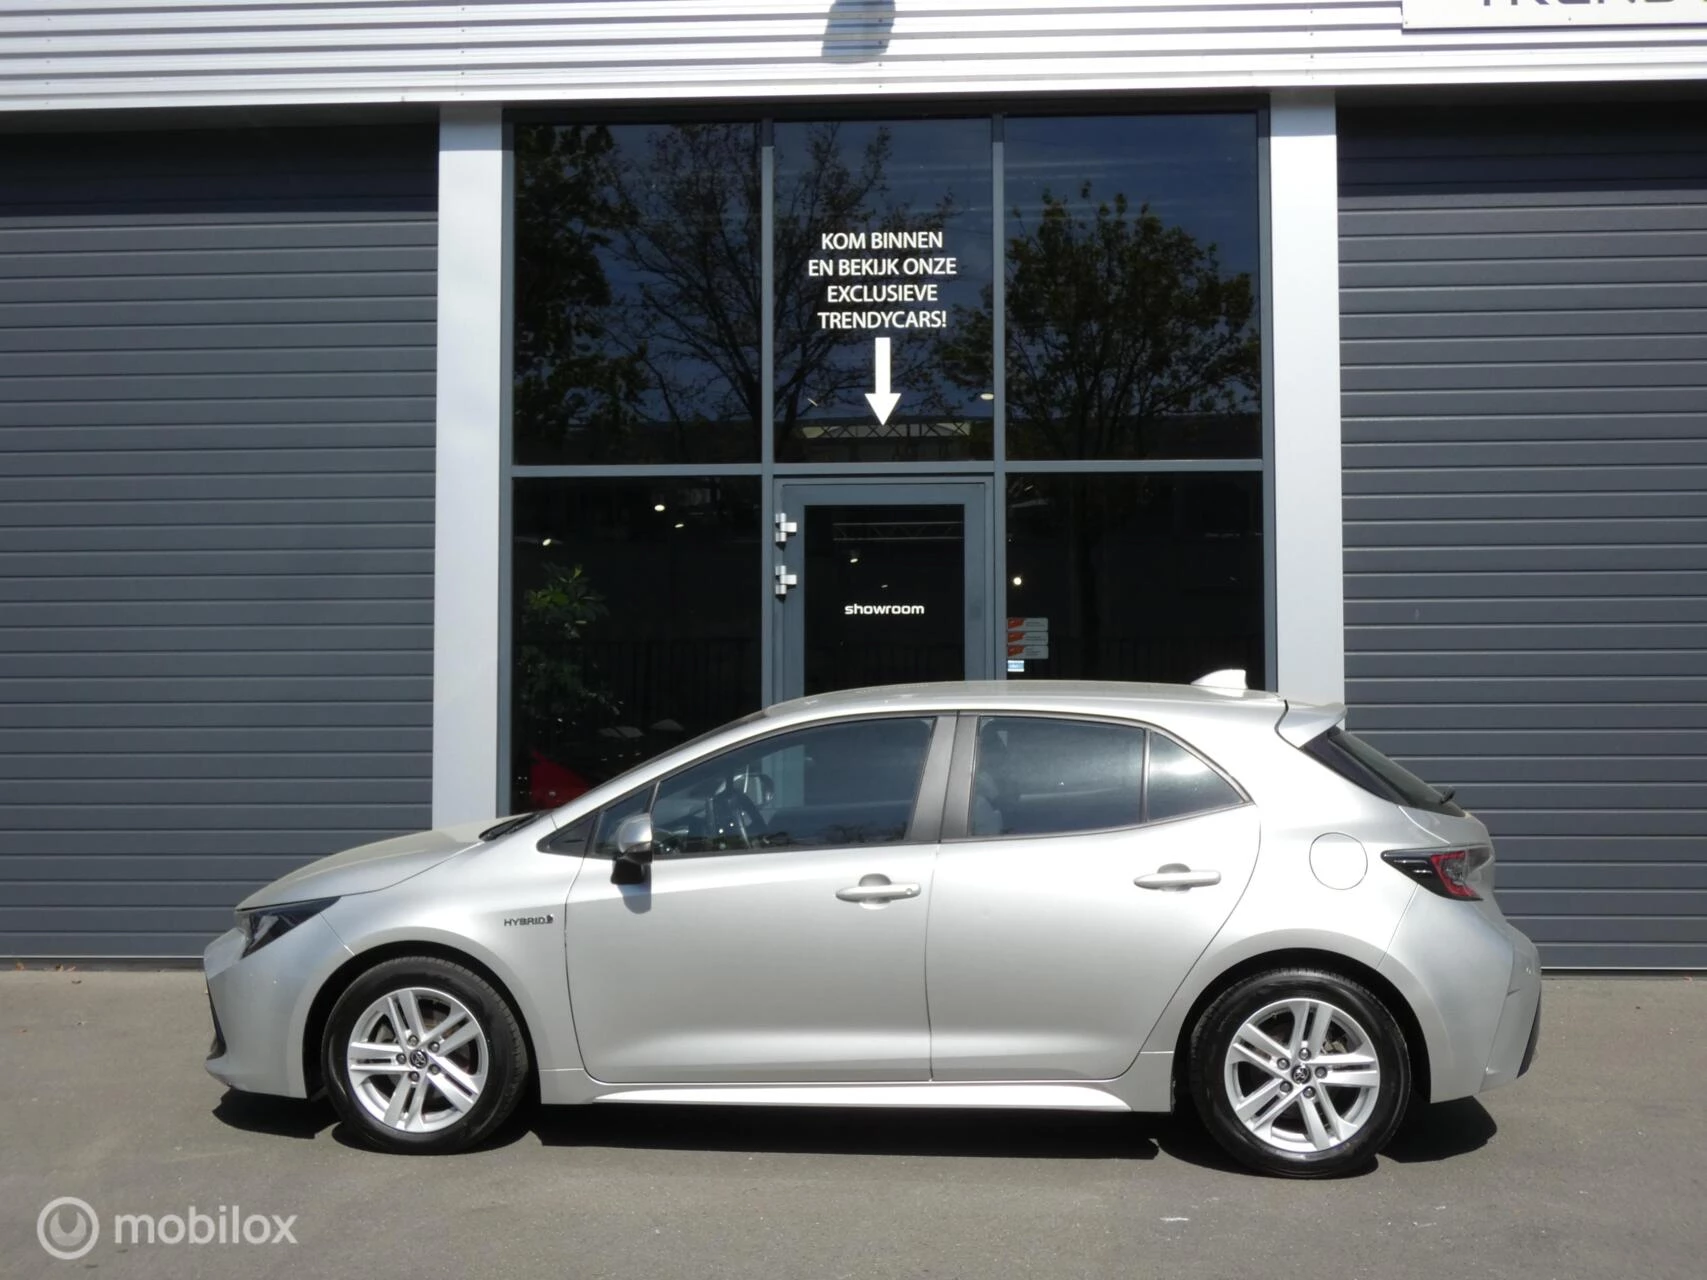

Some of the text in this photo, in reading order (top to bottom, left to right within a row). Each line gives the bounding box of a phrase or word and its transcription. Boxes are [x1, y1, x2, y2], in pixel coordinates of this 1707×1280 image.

[821, 231, 943, 250] KOM BINNEN
[808, 257, 957, 276] EN BEKIJK ONZE
[827, 284, 938, 303] EXCLUSIEVE
[817, 310, 947, 329] TRENDYCARS!
[844, 603, 925, 615] showroom
[503, 916, 546, 927] HYBRID
